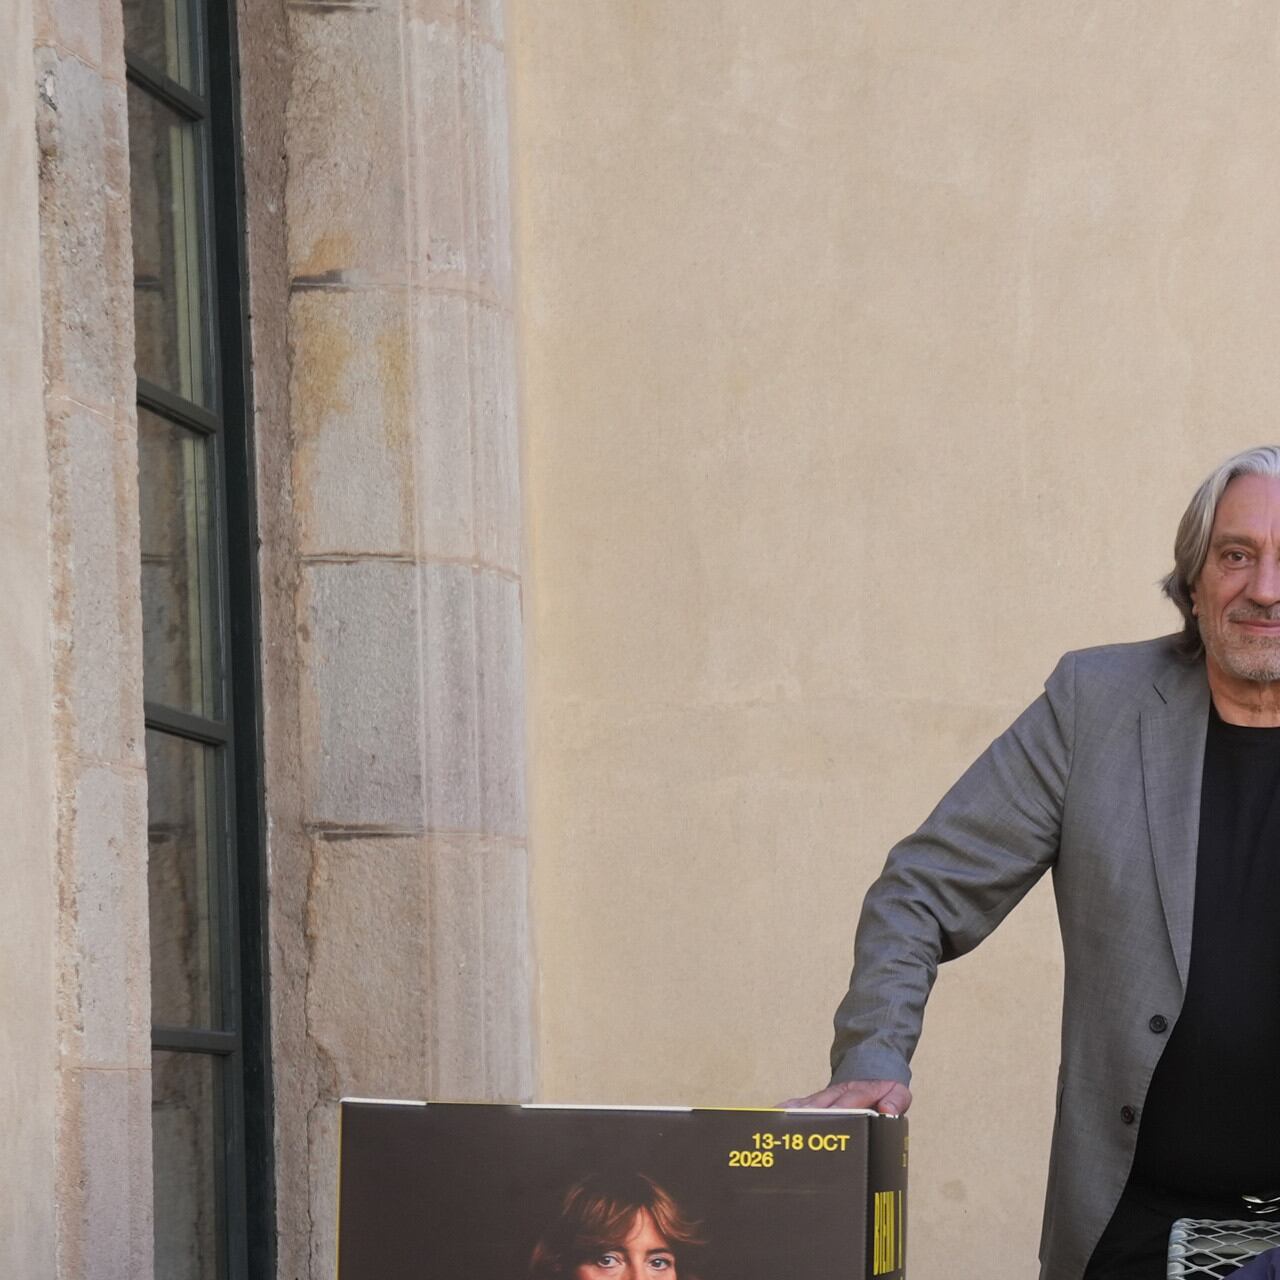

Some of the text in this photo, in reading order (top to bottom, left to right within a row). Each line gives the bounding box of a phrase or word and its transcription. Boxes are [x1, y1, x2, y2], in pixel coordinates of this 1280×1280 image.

[752, 1132, 849, 1152] 13-18 OCT
[729, 1151, 774, 1169] 2026
